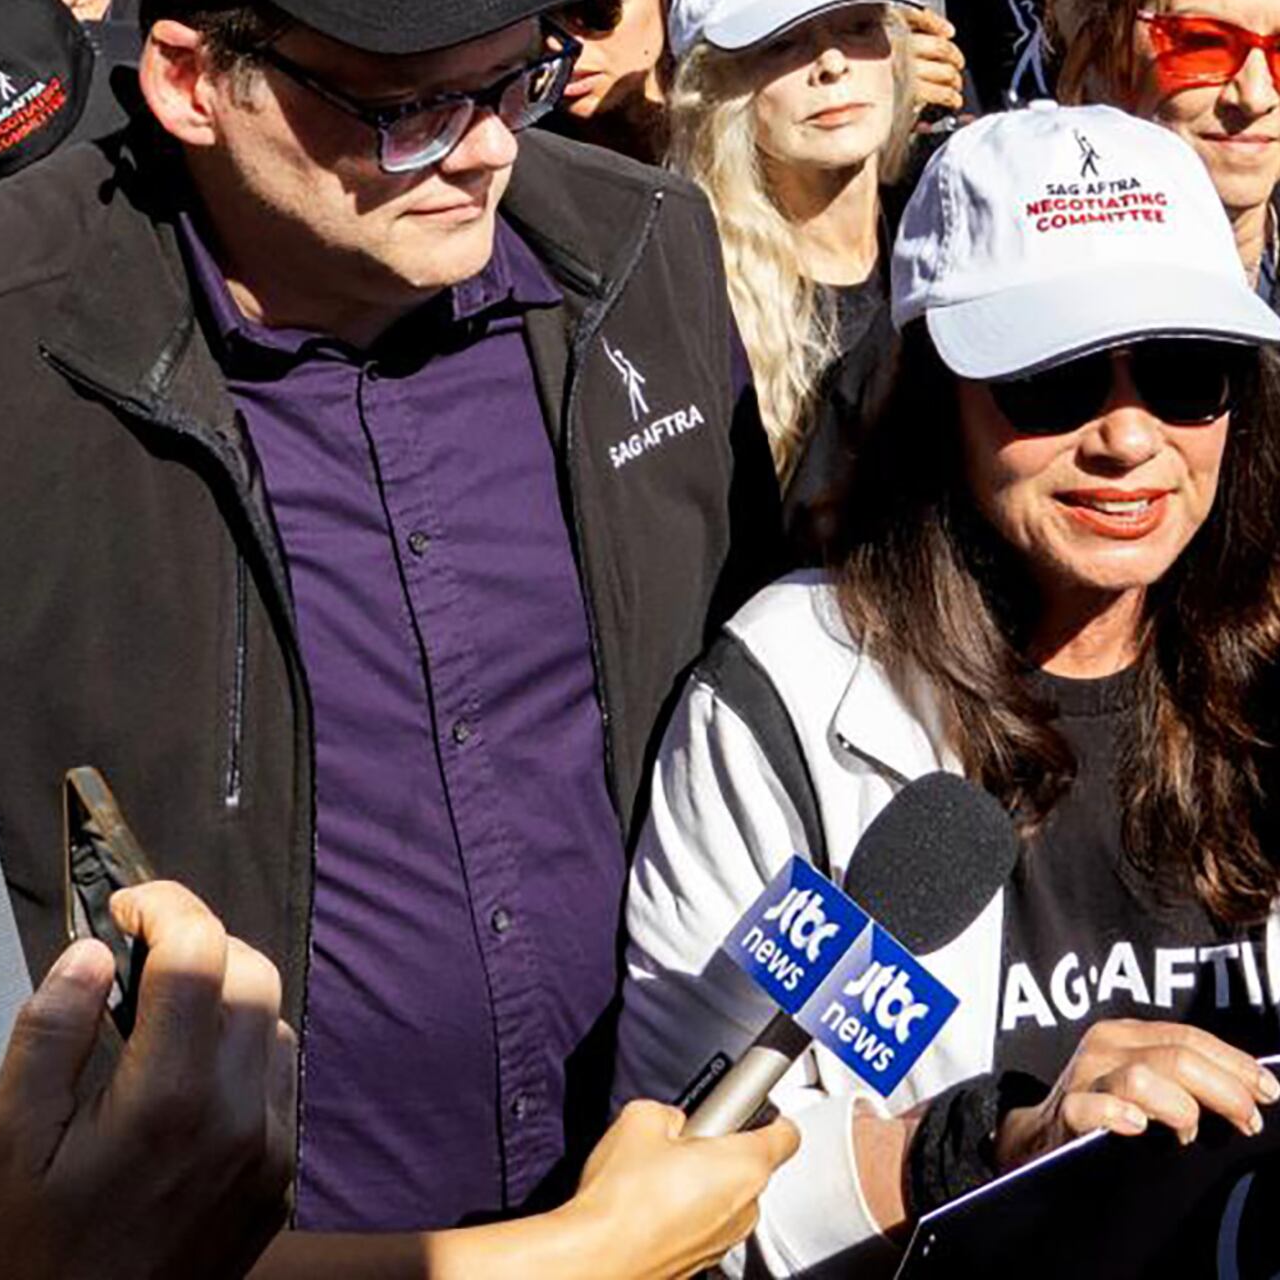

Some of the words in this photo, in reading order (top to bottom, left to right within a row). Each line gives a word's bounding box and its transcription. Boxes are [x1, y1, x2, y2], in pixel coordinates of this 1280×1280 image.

[1026, 192, 1168, 217] NEGOTIATING
[1036, 209, 1166, 233] COMMITTEE
[741, 926, 805, 991] news
[821, 1001, 895, 1073] news
